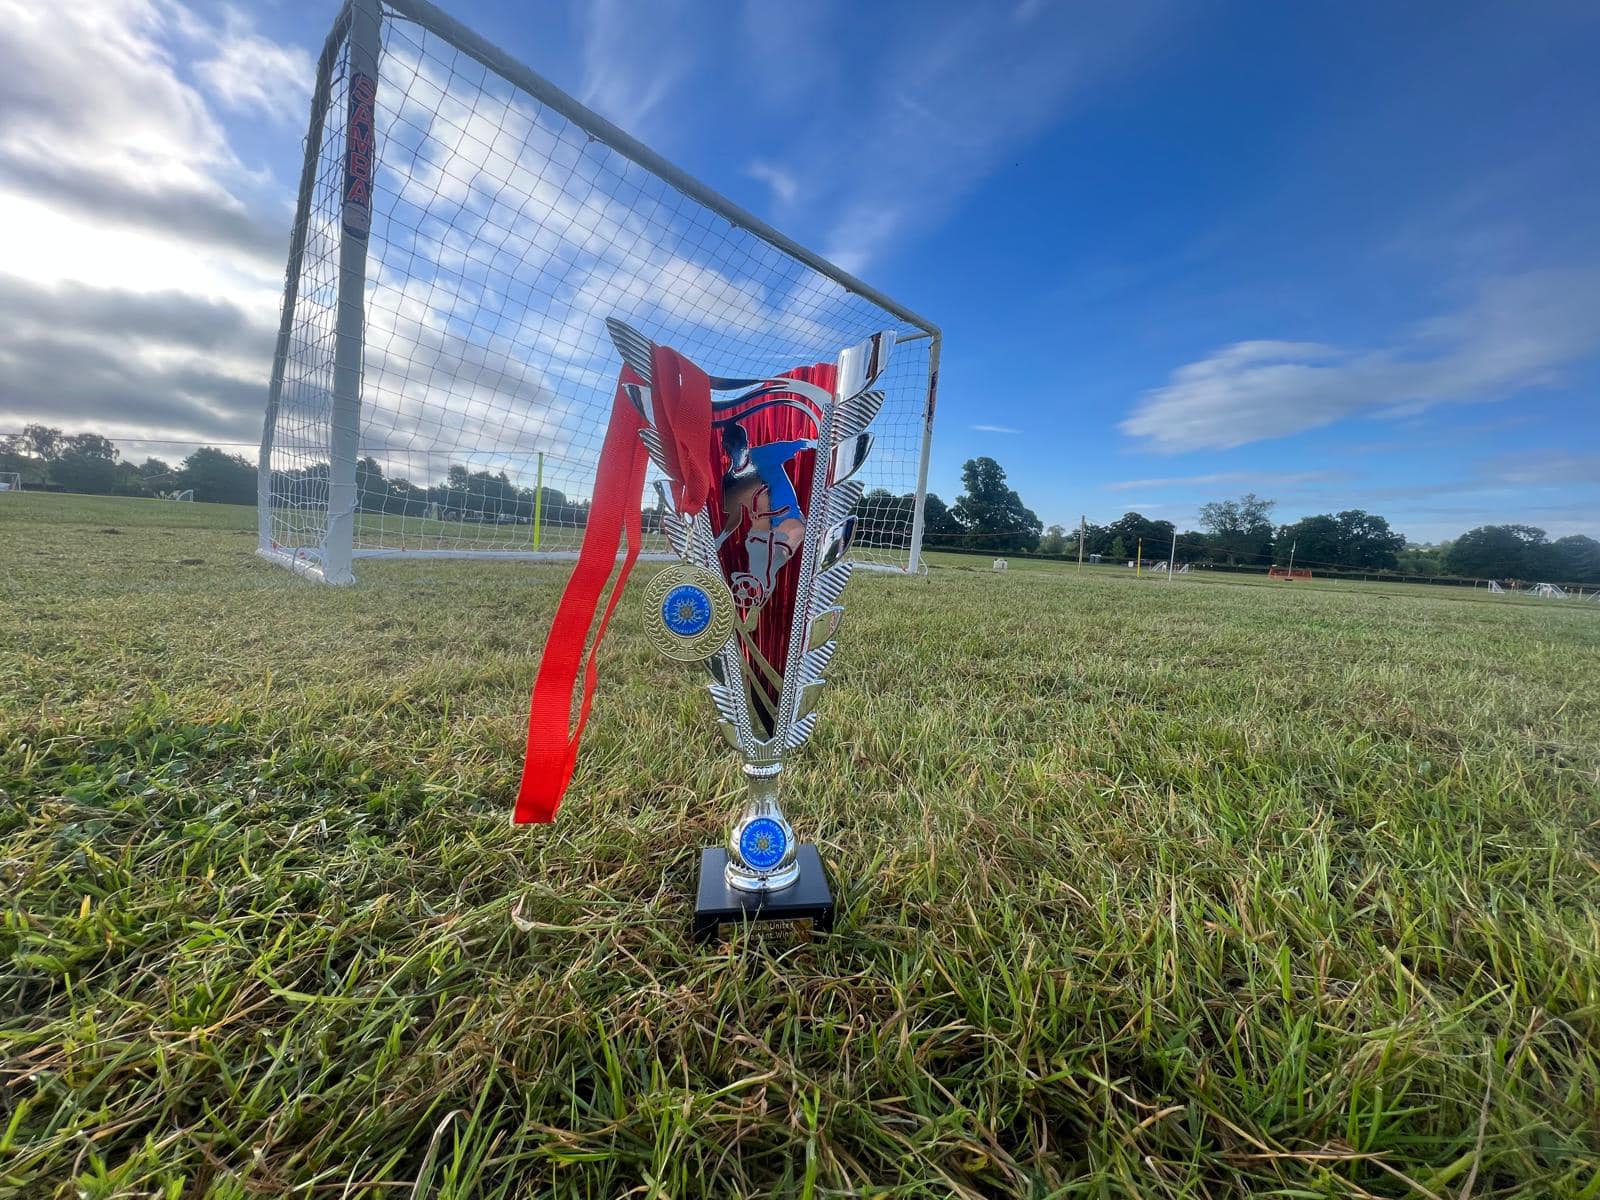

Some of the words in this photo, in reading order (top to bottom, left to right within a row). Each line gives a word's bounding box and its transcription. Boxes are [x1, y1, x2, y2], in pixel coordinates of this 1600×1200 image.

[348, 74, 376, 207] SAMBA
[688, 587, 710, 617] UNITED
[768, 821, 784, 853] UNITED
